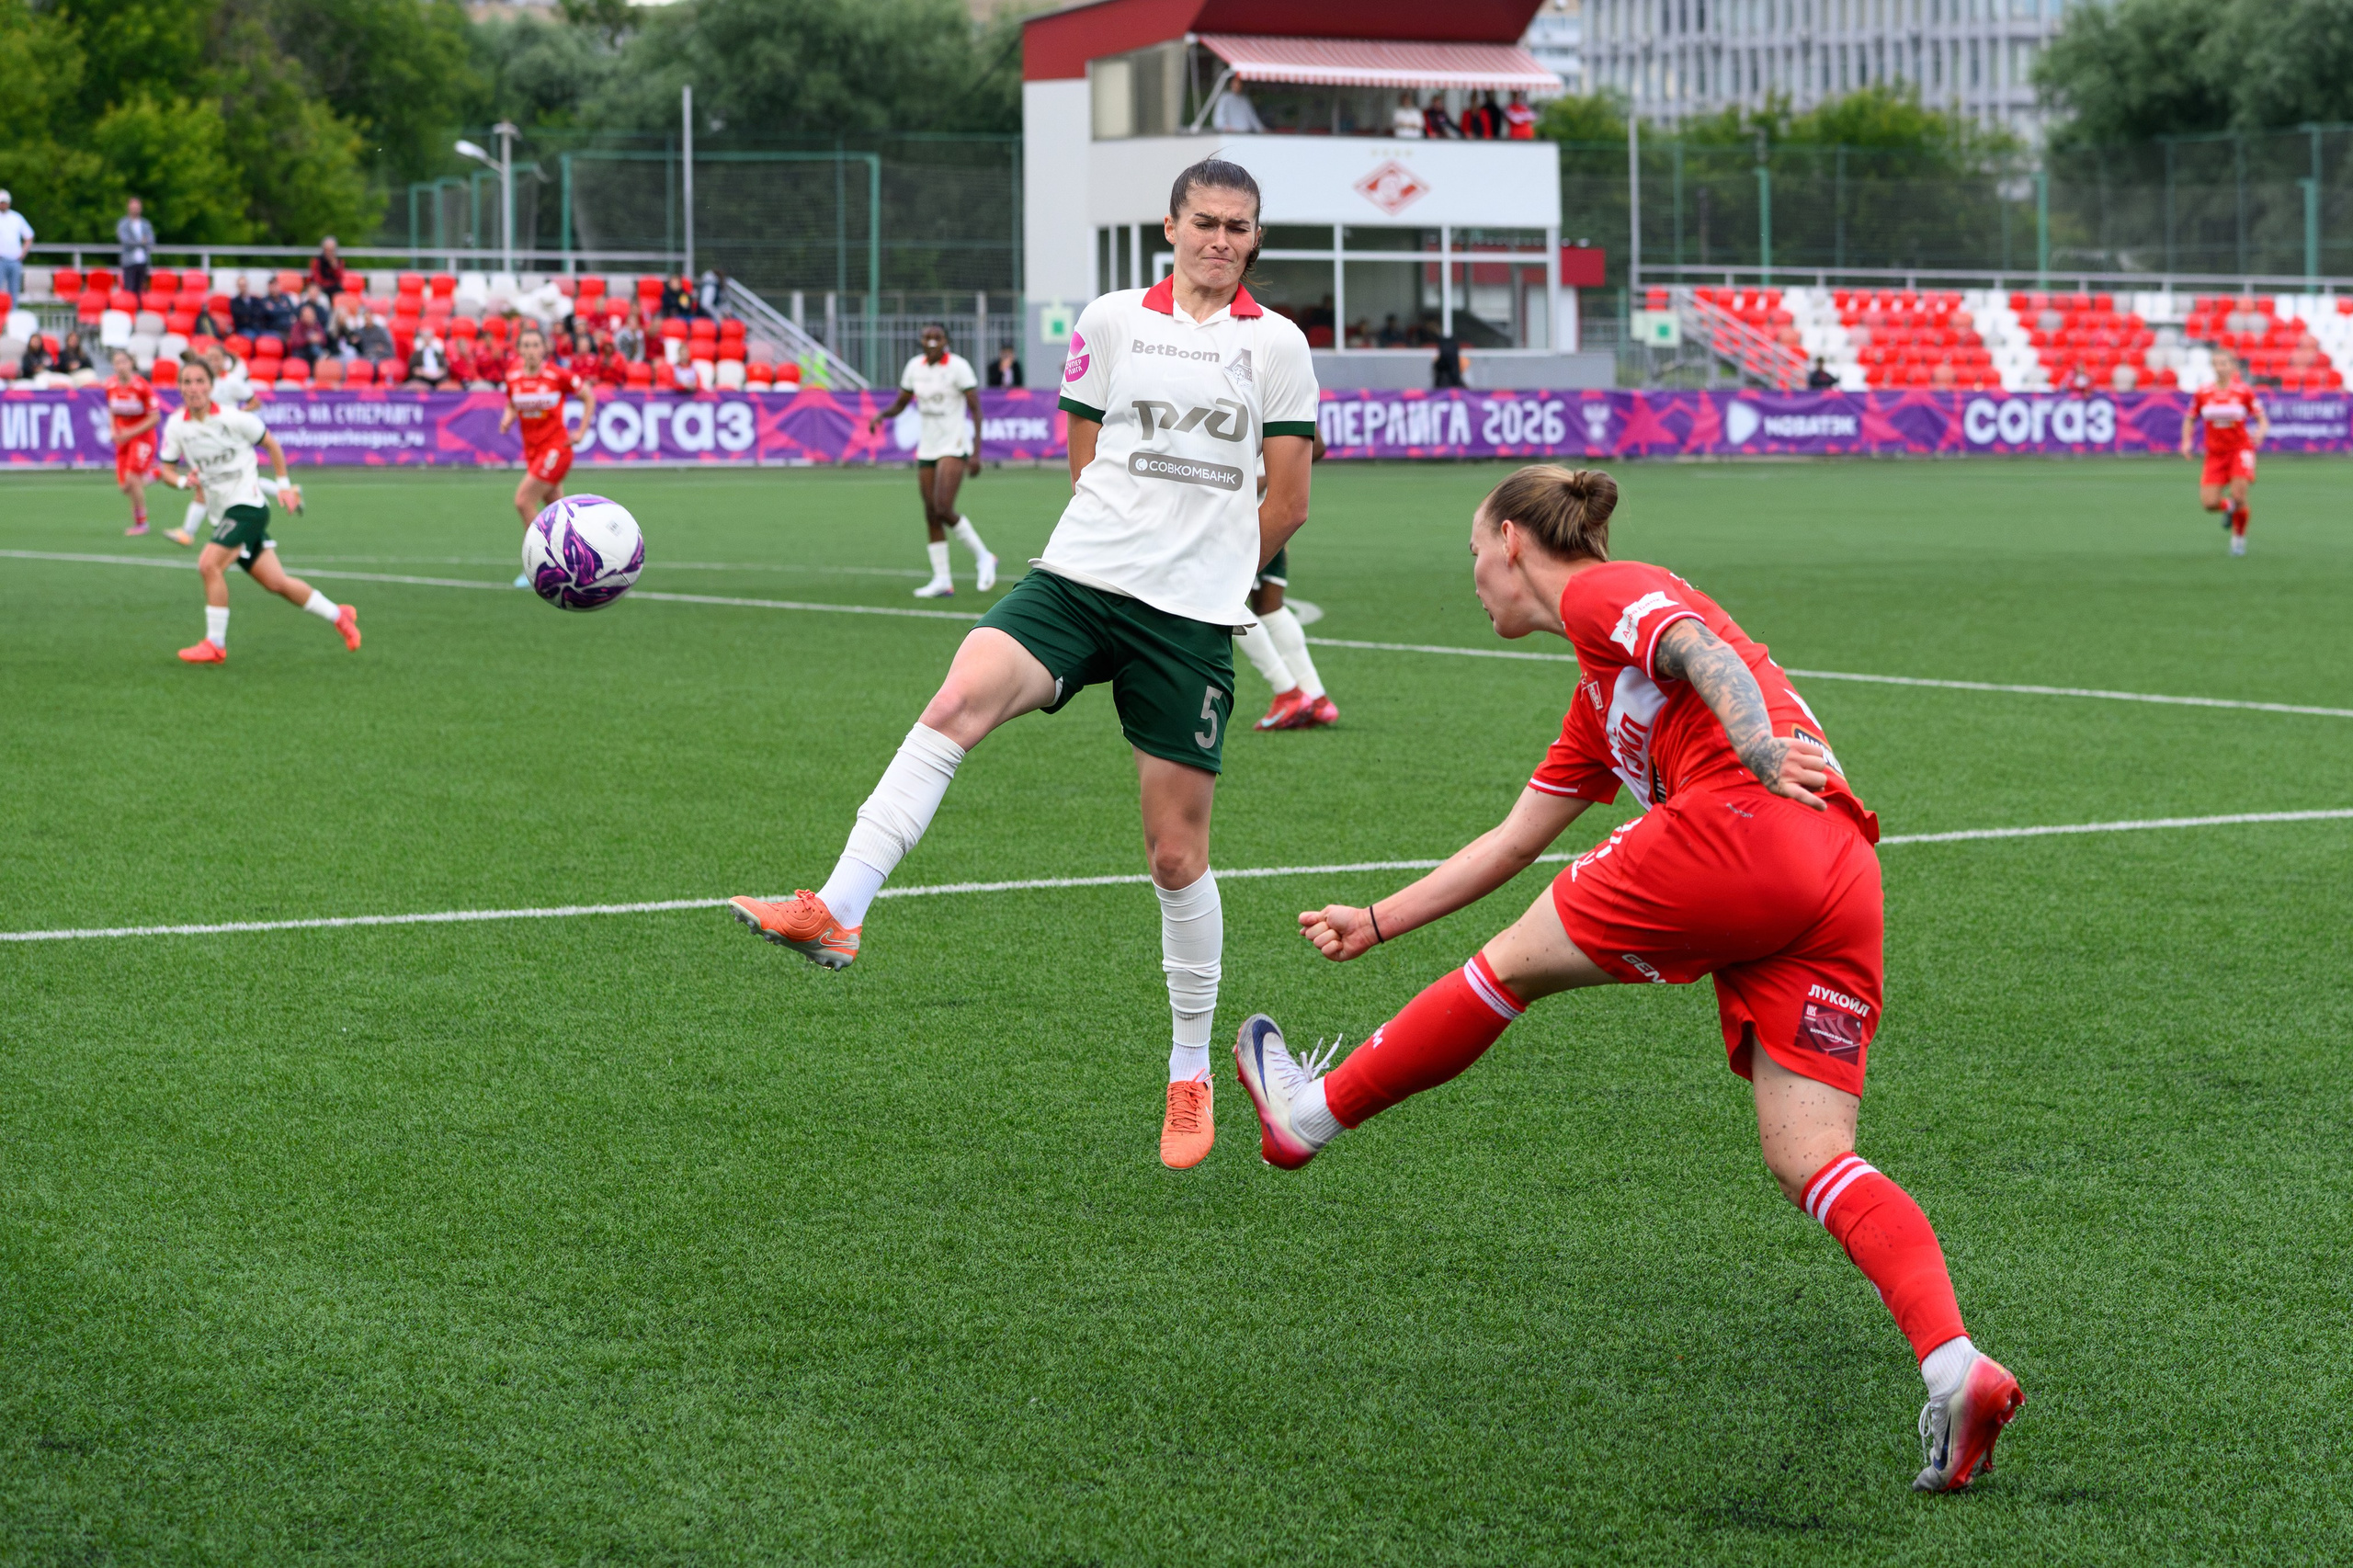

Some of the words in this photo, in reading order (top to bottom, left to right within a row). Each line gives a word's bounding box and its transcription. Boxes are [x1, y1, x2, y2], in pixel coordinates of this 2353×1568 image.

[1131, 339, 1221, 363] BetBoom
[1068, 365, 1083, 375] ЛИГА
[1482, 400, 1565, 445] 2026
[1149, 460, 1236, 484] СОВКОМБАНК
[1195, 686, 1223, 749] 5
[1808, 983, 1870, 1017] ЛУКОЙЛ
